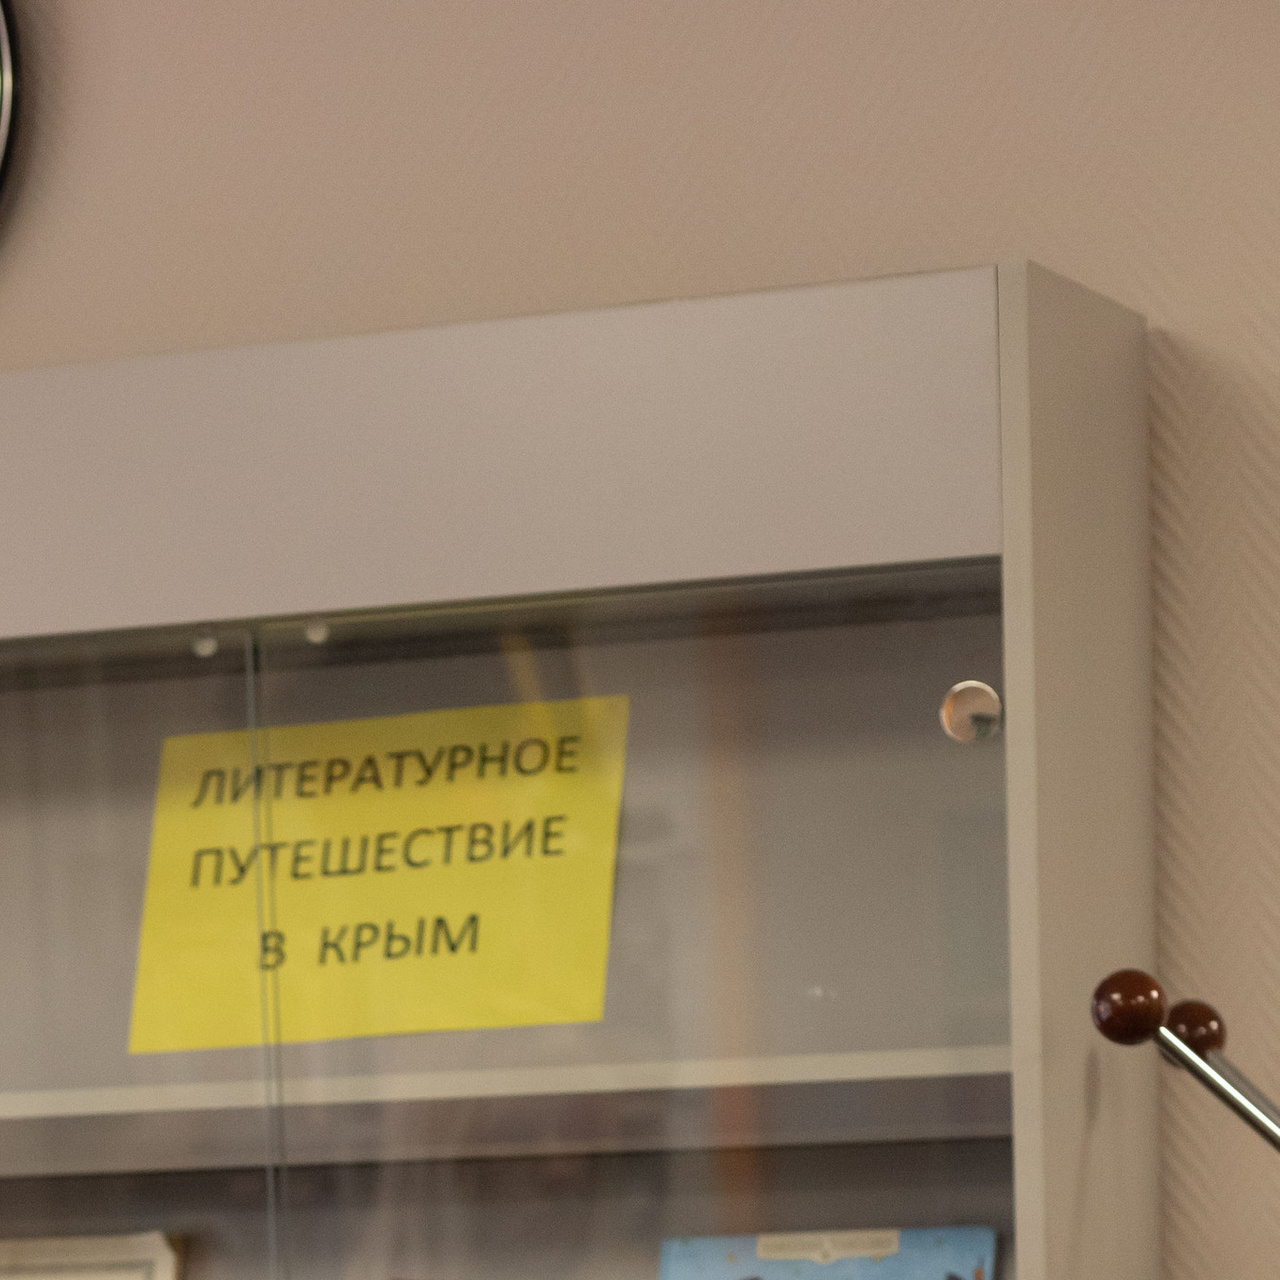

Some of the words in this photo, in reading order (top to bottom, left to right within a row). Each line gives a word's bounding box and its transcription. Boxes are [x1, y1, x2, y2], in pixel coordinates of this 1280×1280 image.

[191, 735, 583, 808] ЛИТЕРАТУРНОЕ
[189, 815, 568, 888] ПУТЕШЕСТВИЕ
[258, 930, 288, 971] В
[317, 913, 481, 967] КРЫМ
